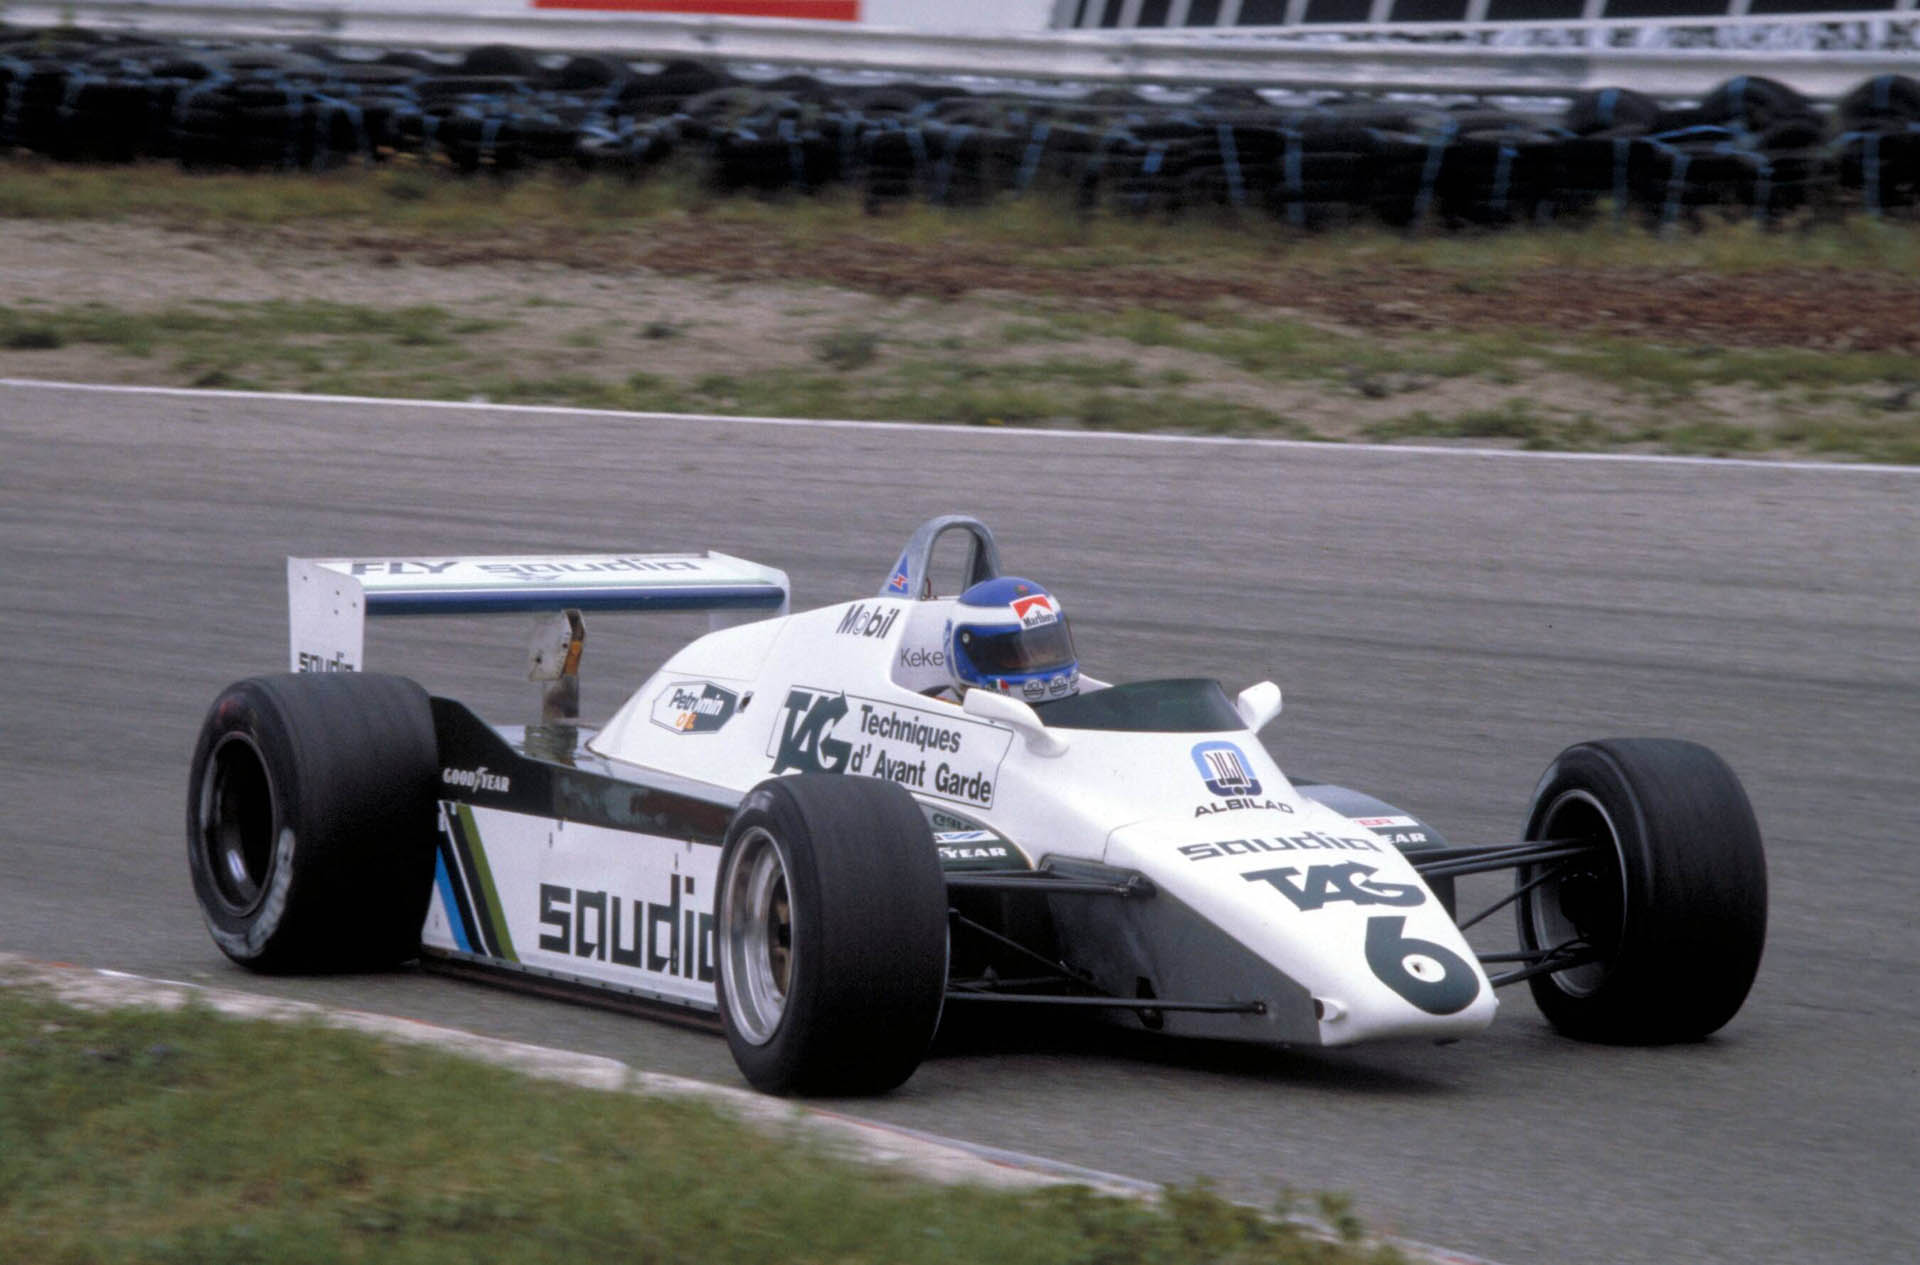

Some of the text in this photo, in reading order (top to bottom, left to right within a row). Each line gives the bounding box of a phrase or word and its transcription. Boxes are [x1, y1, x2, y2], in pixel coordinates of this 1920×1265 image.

[351, 560, 460, 576] FLY
[836, 603, 901, 640] Mobil
[900, 647, 945, 668] Keke
[769, 690, 854, 775] TAG
[860, 703, 962, 754] Techniques
[872, 749, 927, 789] Avant
[934, 761, 993, 803] Garde
[1194, 797, 1295, 818] ALBILAD
[1177, 830, 1385, 861] saudia
[1239, 859, 1427, 912] TAG
[1364, 915, 1481, 1016] 6
